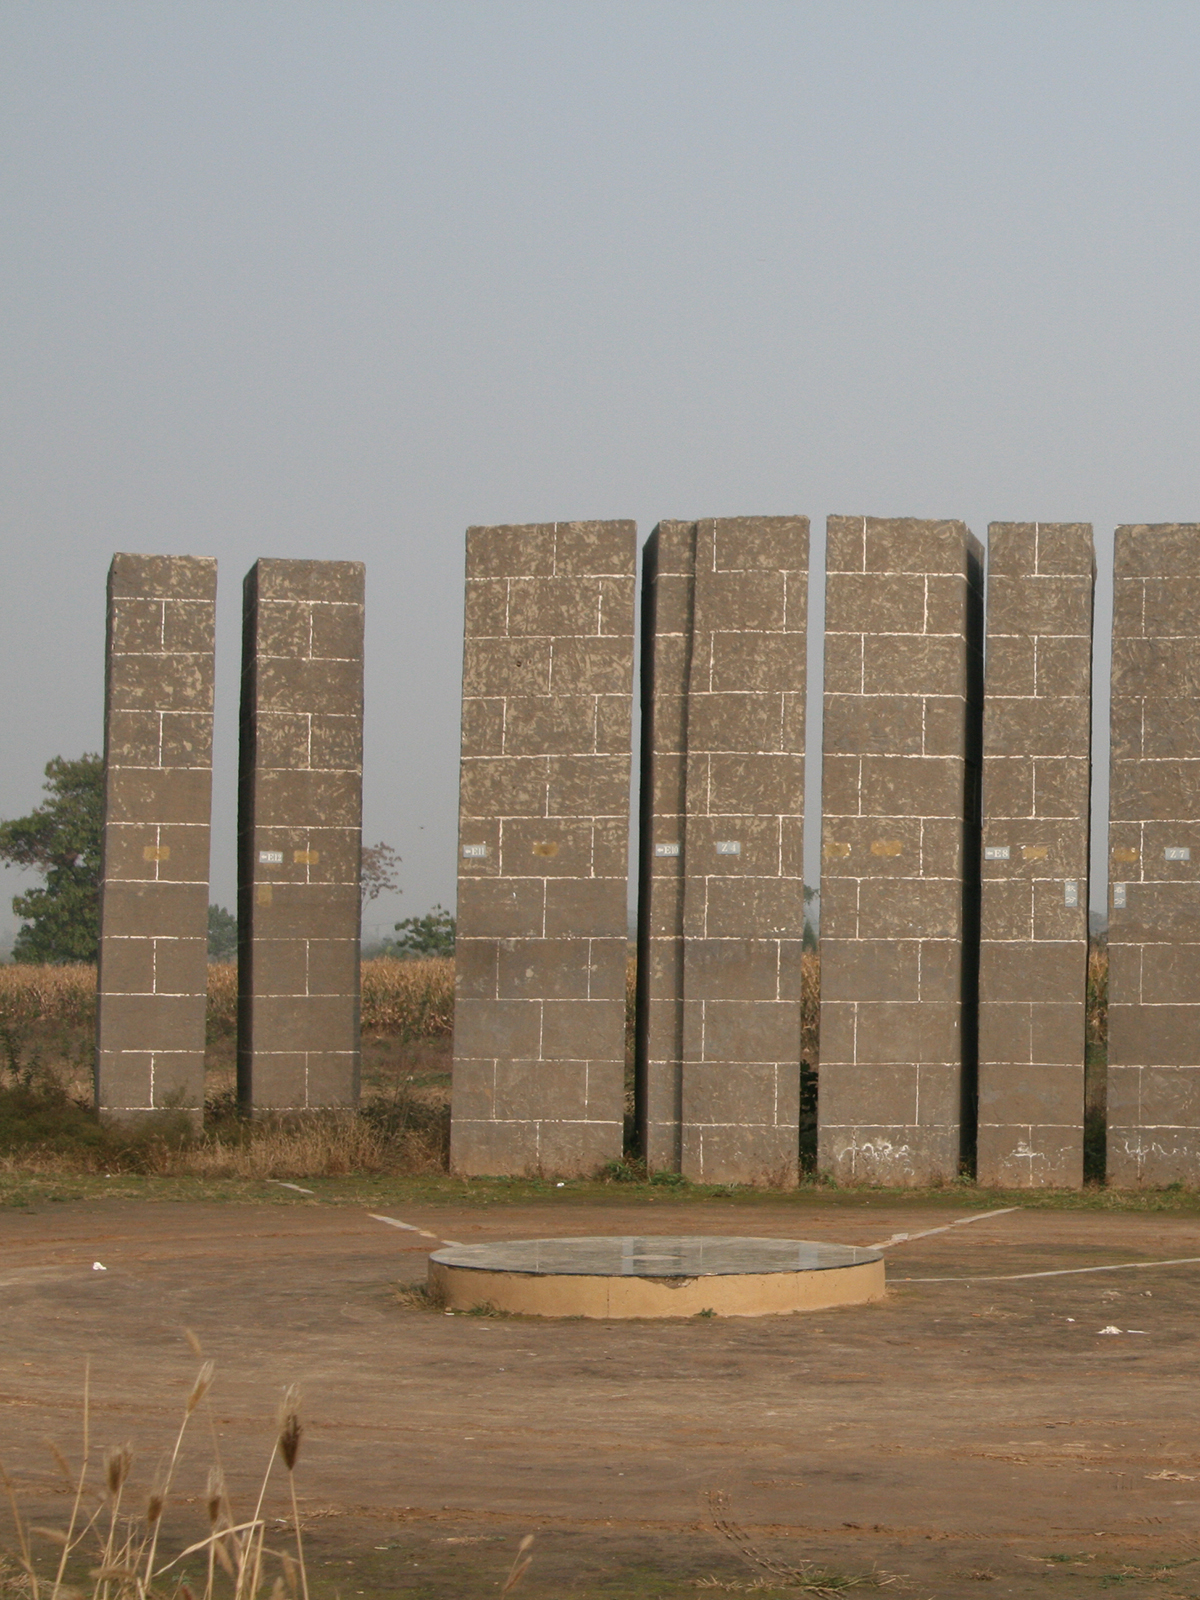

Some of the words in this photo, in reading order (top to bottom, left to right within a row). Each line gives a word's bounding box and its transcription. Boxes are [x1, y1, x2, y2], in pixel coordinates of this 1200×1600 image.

[471, 847, 485, 856] E11
[664, 846, 679, 854] E10
[994, 849, 1008, 858] E8
[267, 853, 282, 861] E12
